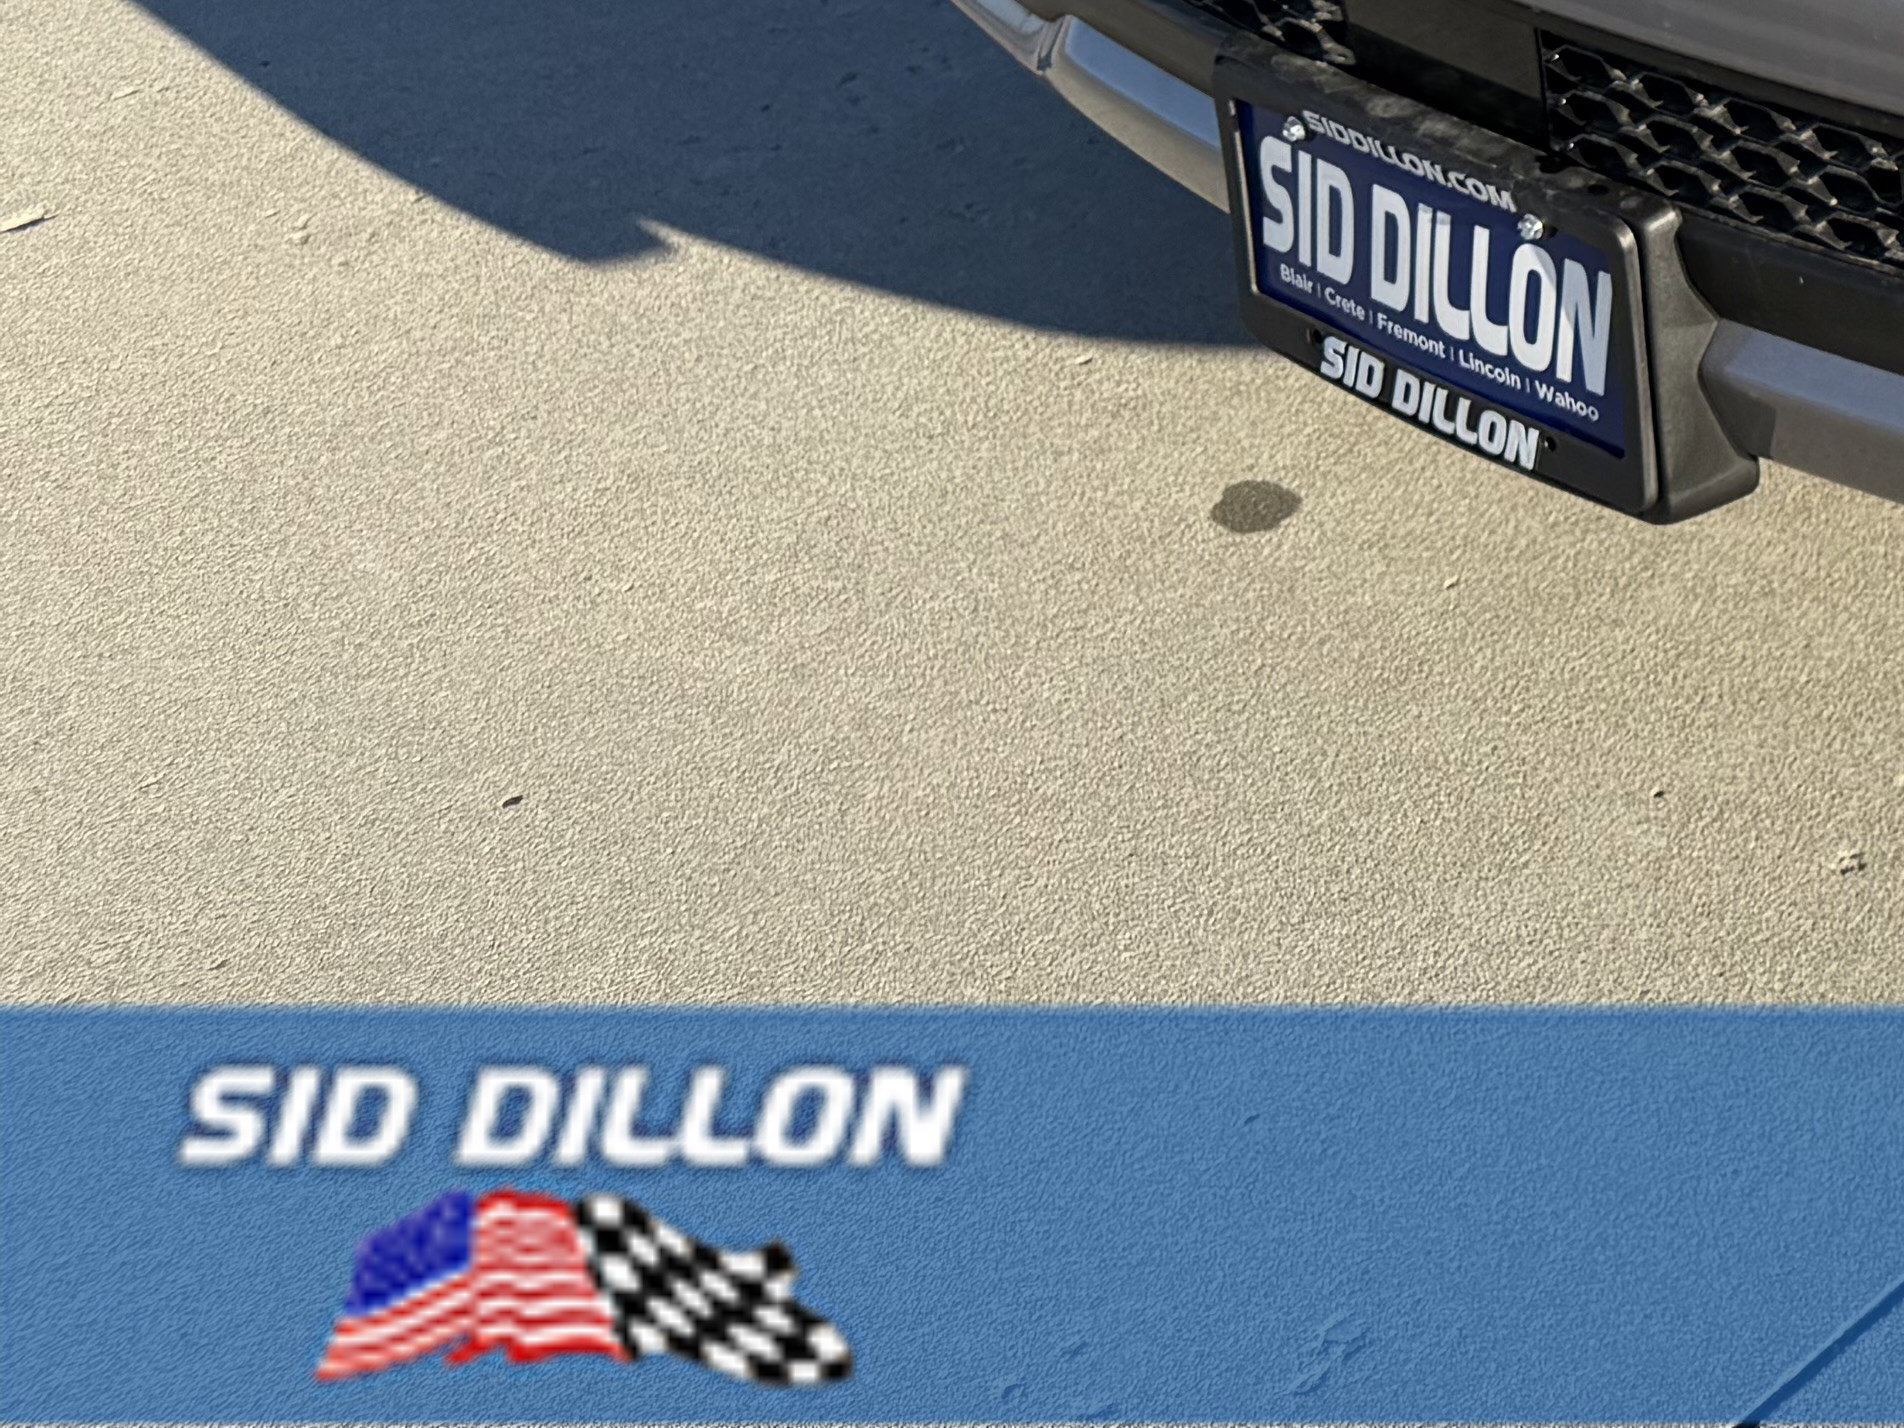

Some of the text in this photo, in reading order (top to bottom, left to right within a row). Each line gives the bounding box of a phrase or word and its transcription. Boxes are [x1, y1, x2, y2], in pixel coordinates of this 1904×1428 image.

[1304, 109, 1516, 214] SIDDILLON.COM
[1259, 134, 1613, 397] SID DILLON
[1279, 262, 1600, 422] Blair Crete Fremont Lincoln Wahoo
[1320, 336, 1540, 471] SID DILLON
